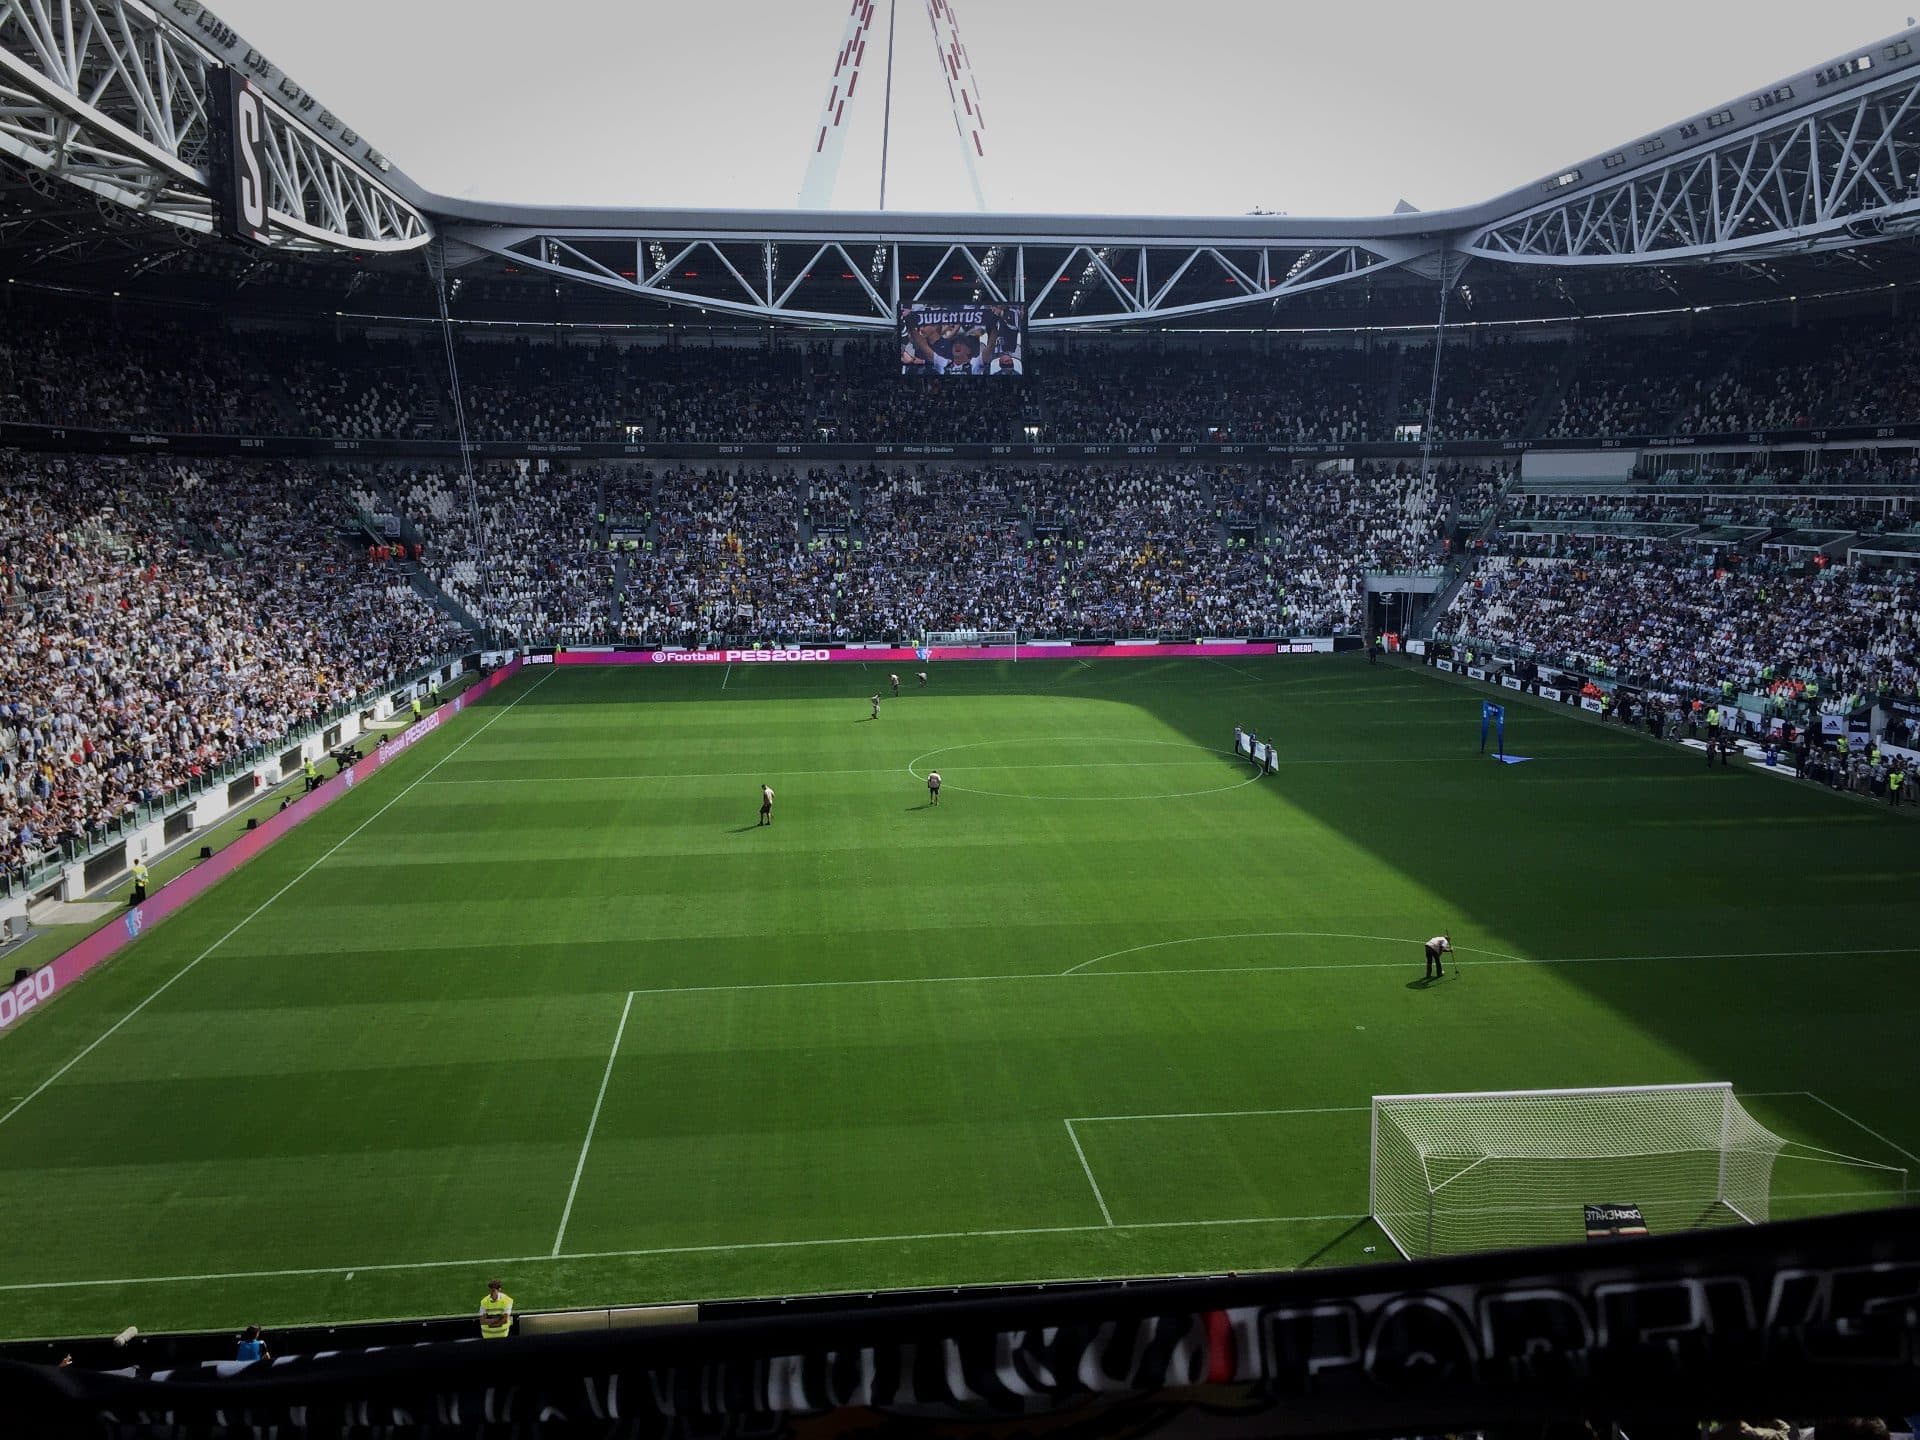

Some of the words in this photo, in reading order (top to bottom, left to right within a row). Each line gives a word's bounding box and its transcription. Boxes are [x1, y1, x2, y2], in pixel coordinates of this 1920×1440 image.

[237, 90, 263, 228] S
[917, 311, 983, 325] JUVENTUS
[527, 444, 548, 452] Allianz
[557, 444, 582, 452] Stadium
[1291, 644, 1312, 653] AHEAD
[726, 649, 830, 662] PES2020
[1439, 661, 1450, 669] Jeep
[1470, 669, 1481, 678] Jeep
[1505, 678, 1516, 688] Jeep
[1543, 687, 1556, 699] Jeep
[1585, 701, 1600, 712] Jeep
